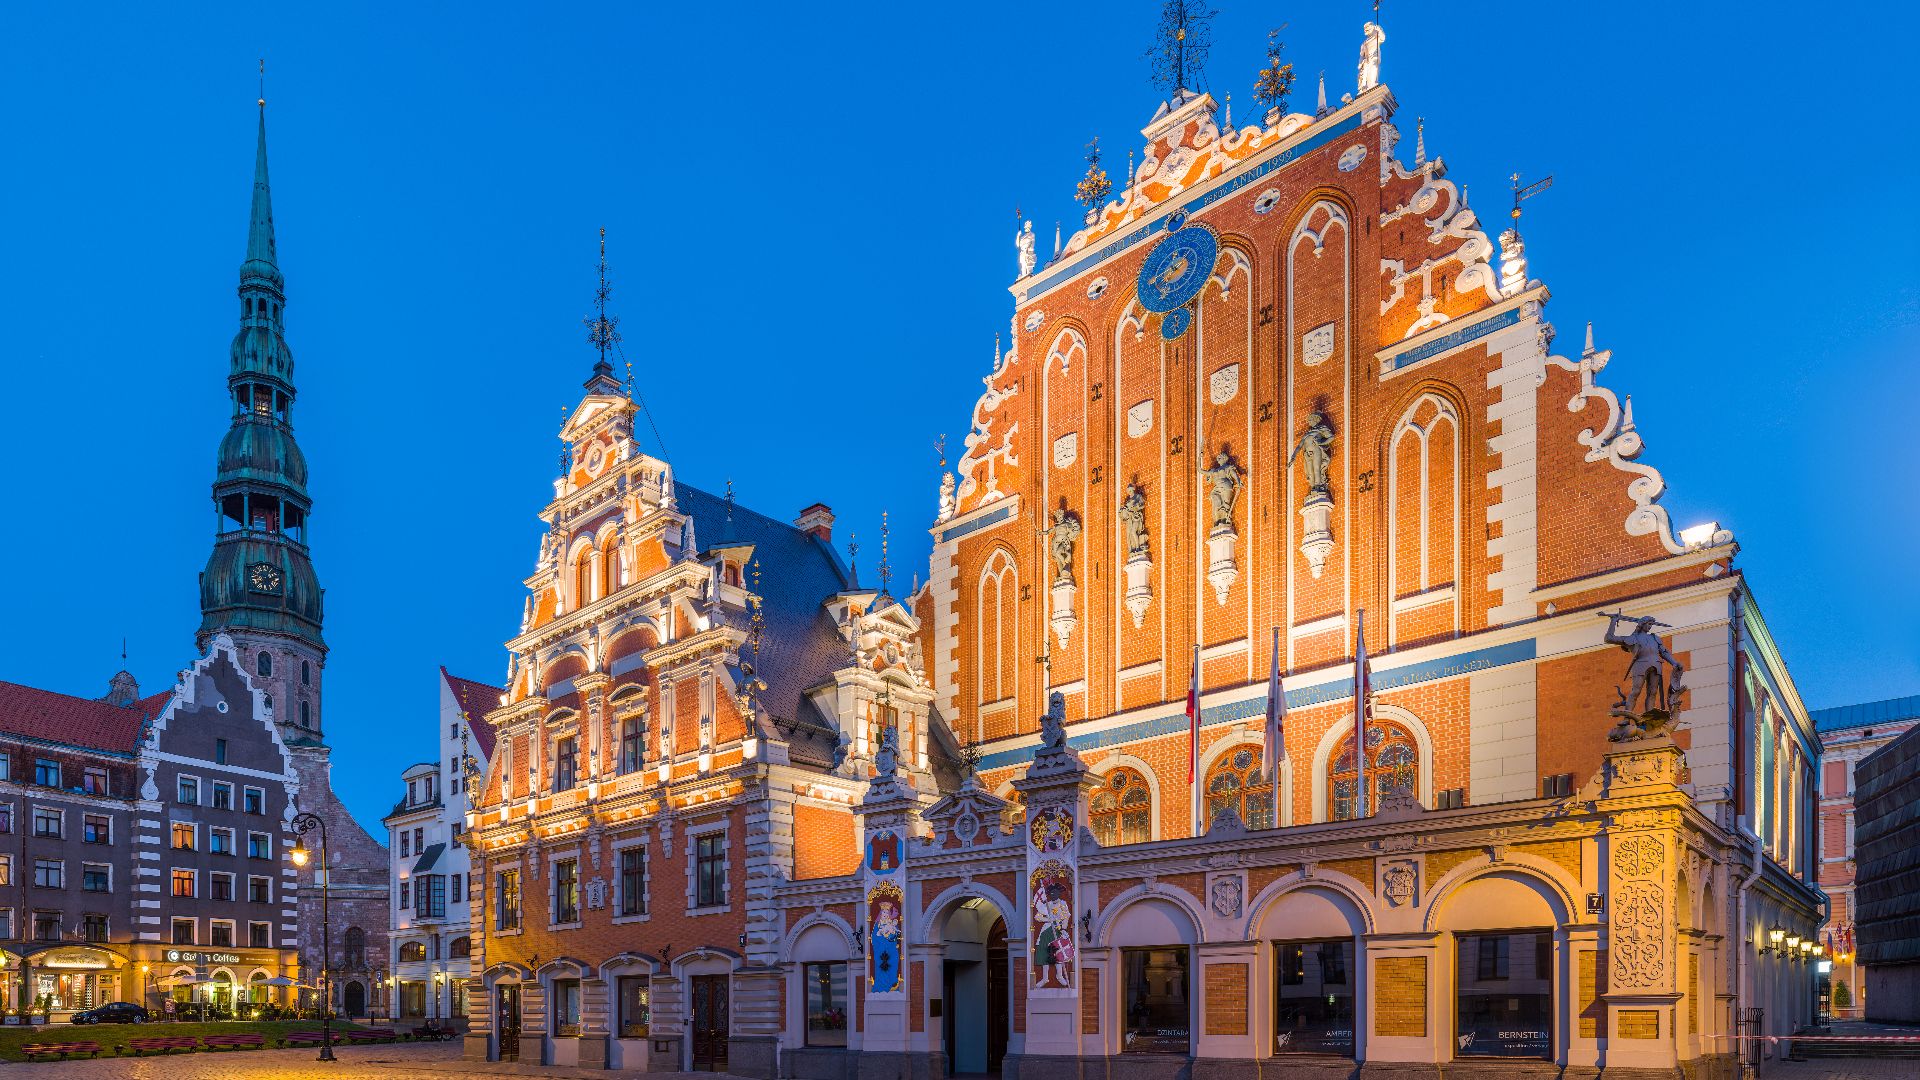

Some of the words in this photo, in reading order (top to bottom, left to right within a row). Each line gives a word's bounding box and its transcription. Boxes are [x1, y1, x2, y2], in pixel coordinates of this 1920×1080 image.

[1230, 166, 1262, 191] ANNO
[1267, 151, 1293, 173] 1999
[1591, 897, 1599, 907] 7
[213, 953, 240, 963] Coffee
[1498, 1031, 1549, 1039] BERNSTEIN
